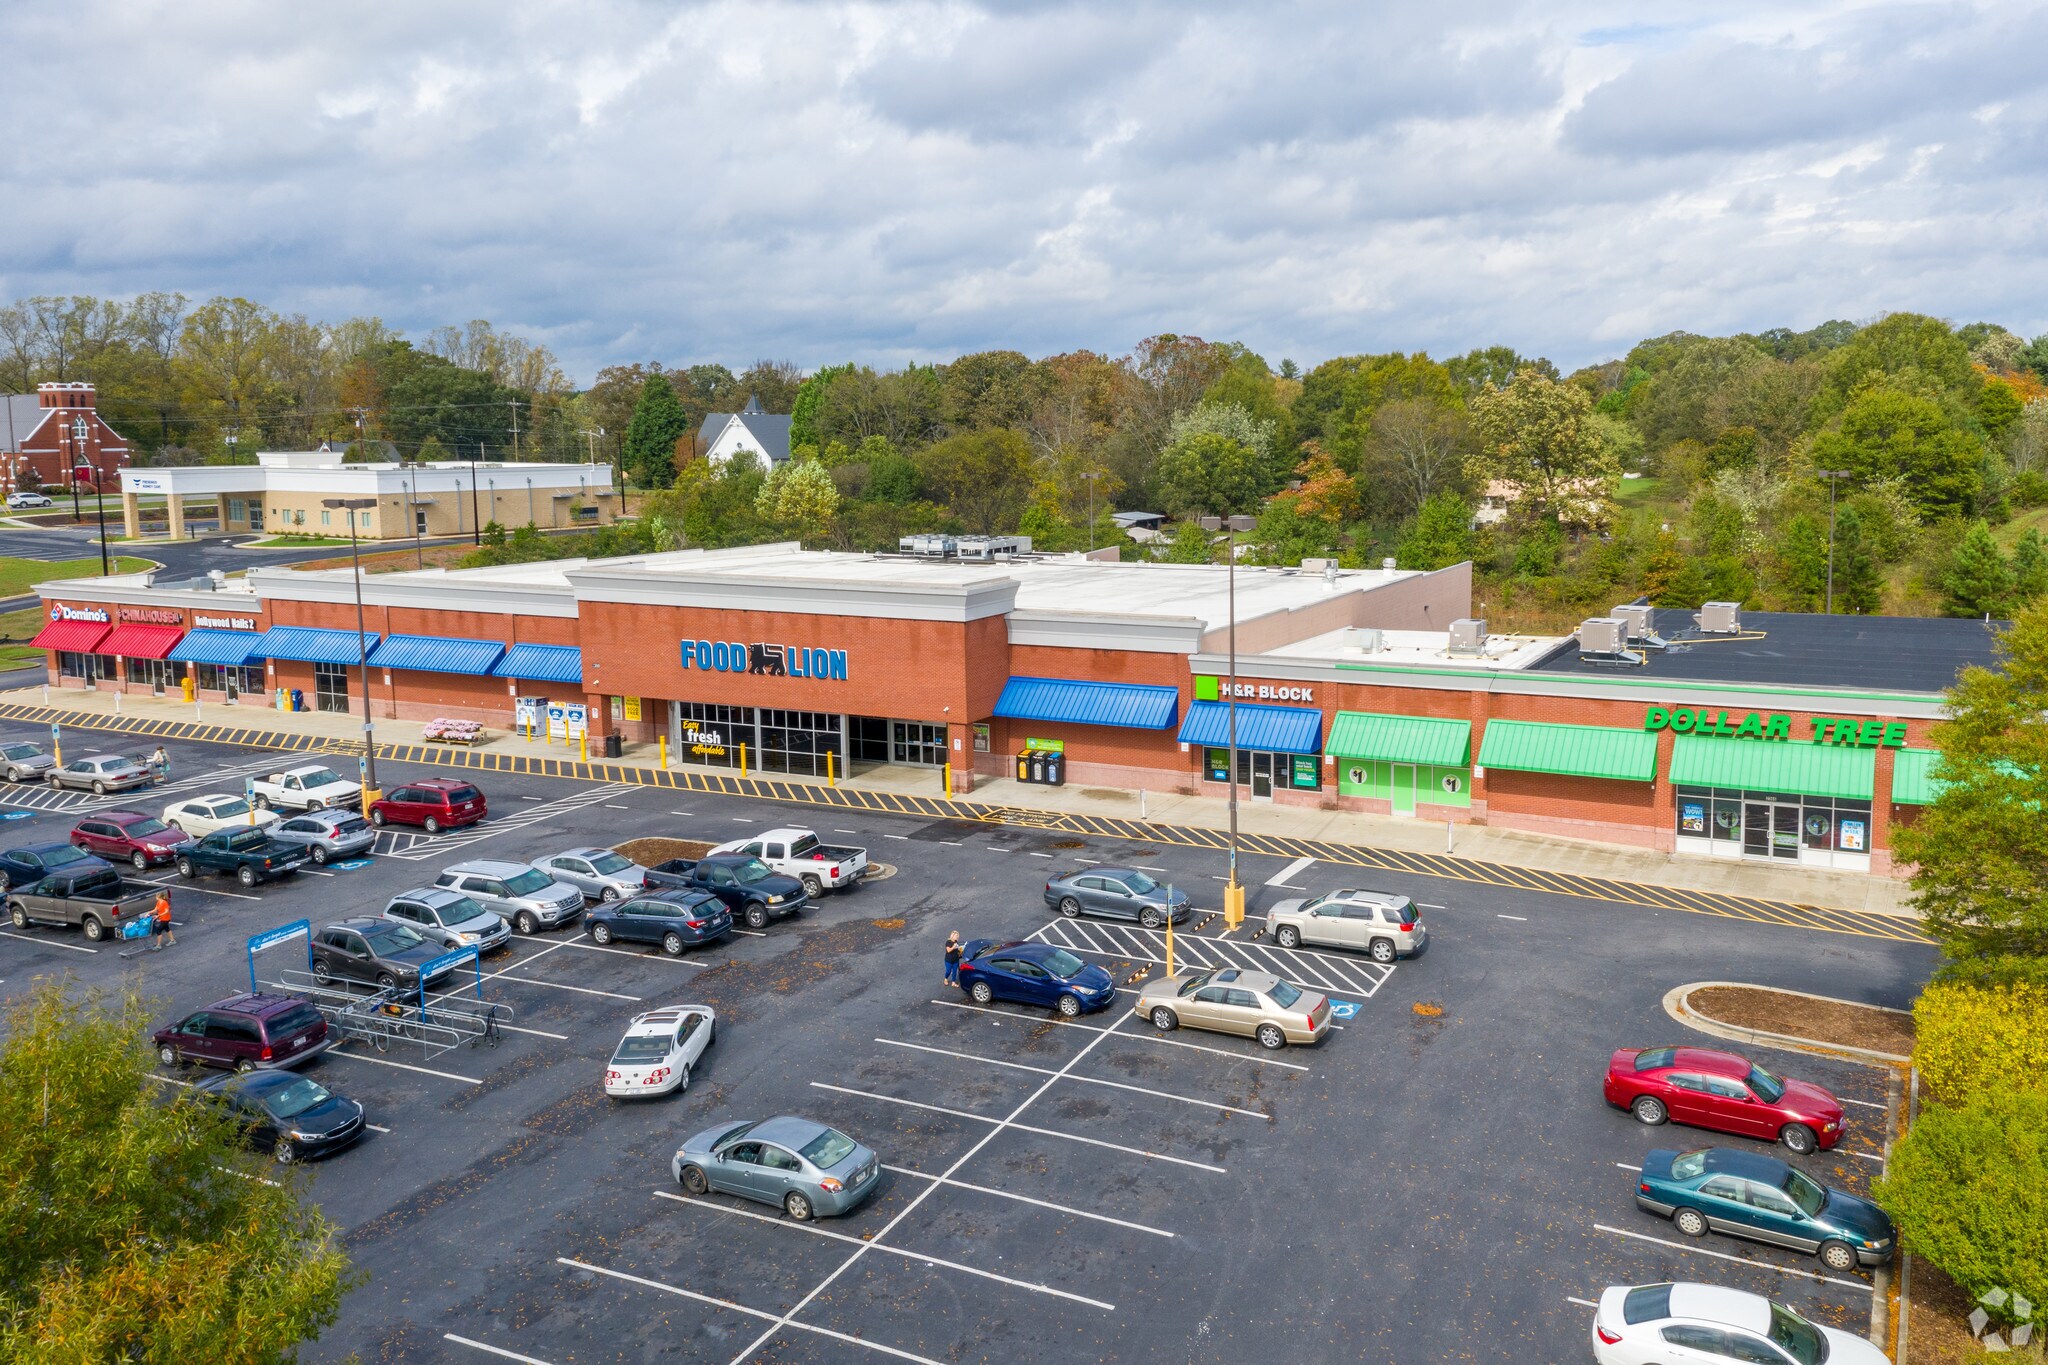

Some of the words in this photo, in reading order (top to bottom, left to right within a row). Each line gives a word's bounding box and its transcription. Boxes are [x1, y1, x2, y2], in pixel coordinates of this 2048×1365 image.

[63, 606, 108, 622] Domino's
[195, 616, 230, 627] Hollywood
[231, 618, 248, 628] Nails
[248, 618, 254, 629] 2
[680, 639, 748, 672] FOOD
[788, 646, 848, 680] LION
[1222, 683, 1255, 698] H&R
[1258, 685, 1313, 702] BLOCK
[682, 720, 700, 733] Easy
[1645, 707, 1792, 737] DOLLAR
[1810, 717, 1908, 746] TREE
[688, 728, 720, 744] fresh
[692, 744, 725, 755] affordable
[1352, 770, 1362, 784] $1
[1446, 778, 1456, 792] $1
[281, 853, 298, 861] TOYOTA
